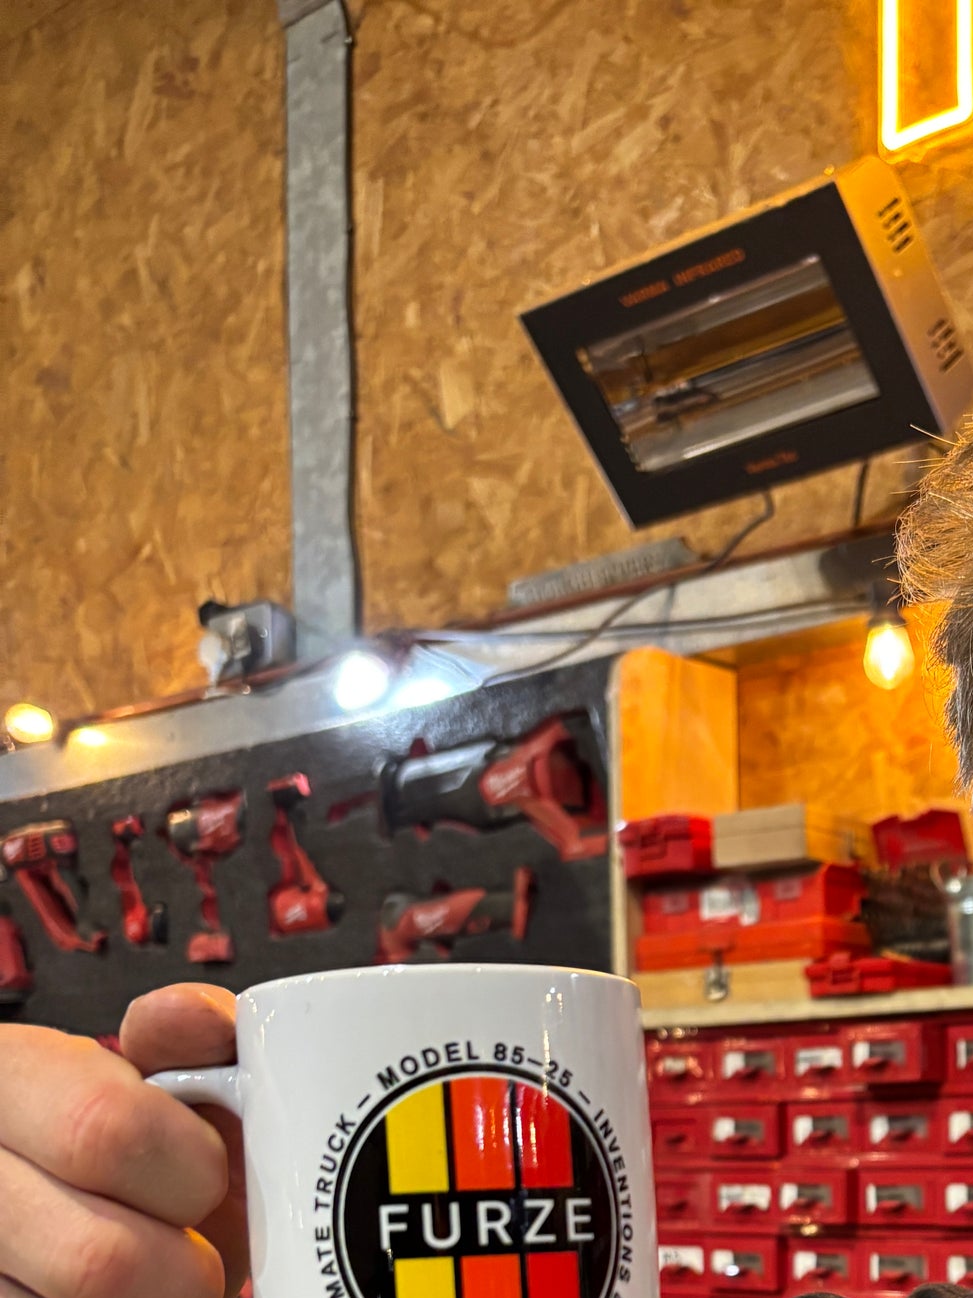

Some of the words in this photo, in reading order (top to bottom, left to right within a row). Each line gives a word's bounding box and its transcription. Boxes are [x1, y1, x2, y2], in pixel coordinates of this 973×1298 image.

[376, 1040, 481, 1090] MODEL
[314, 1114, 357, 1212] TRUCK
[593, 1109, 634, 1284] INVENTIONS
[379, 1198, 595, 1251] FURZE
